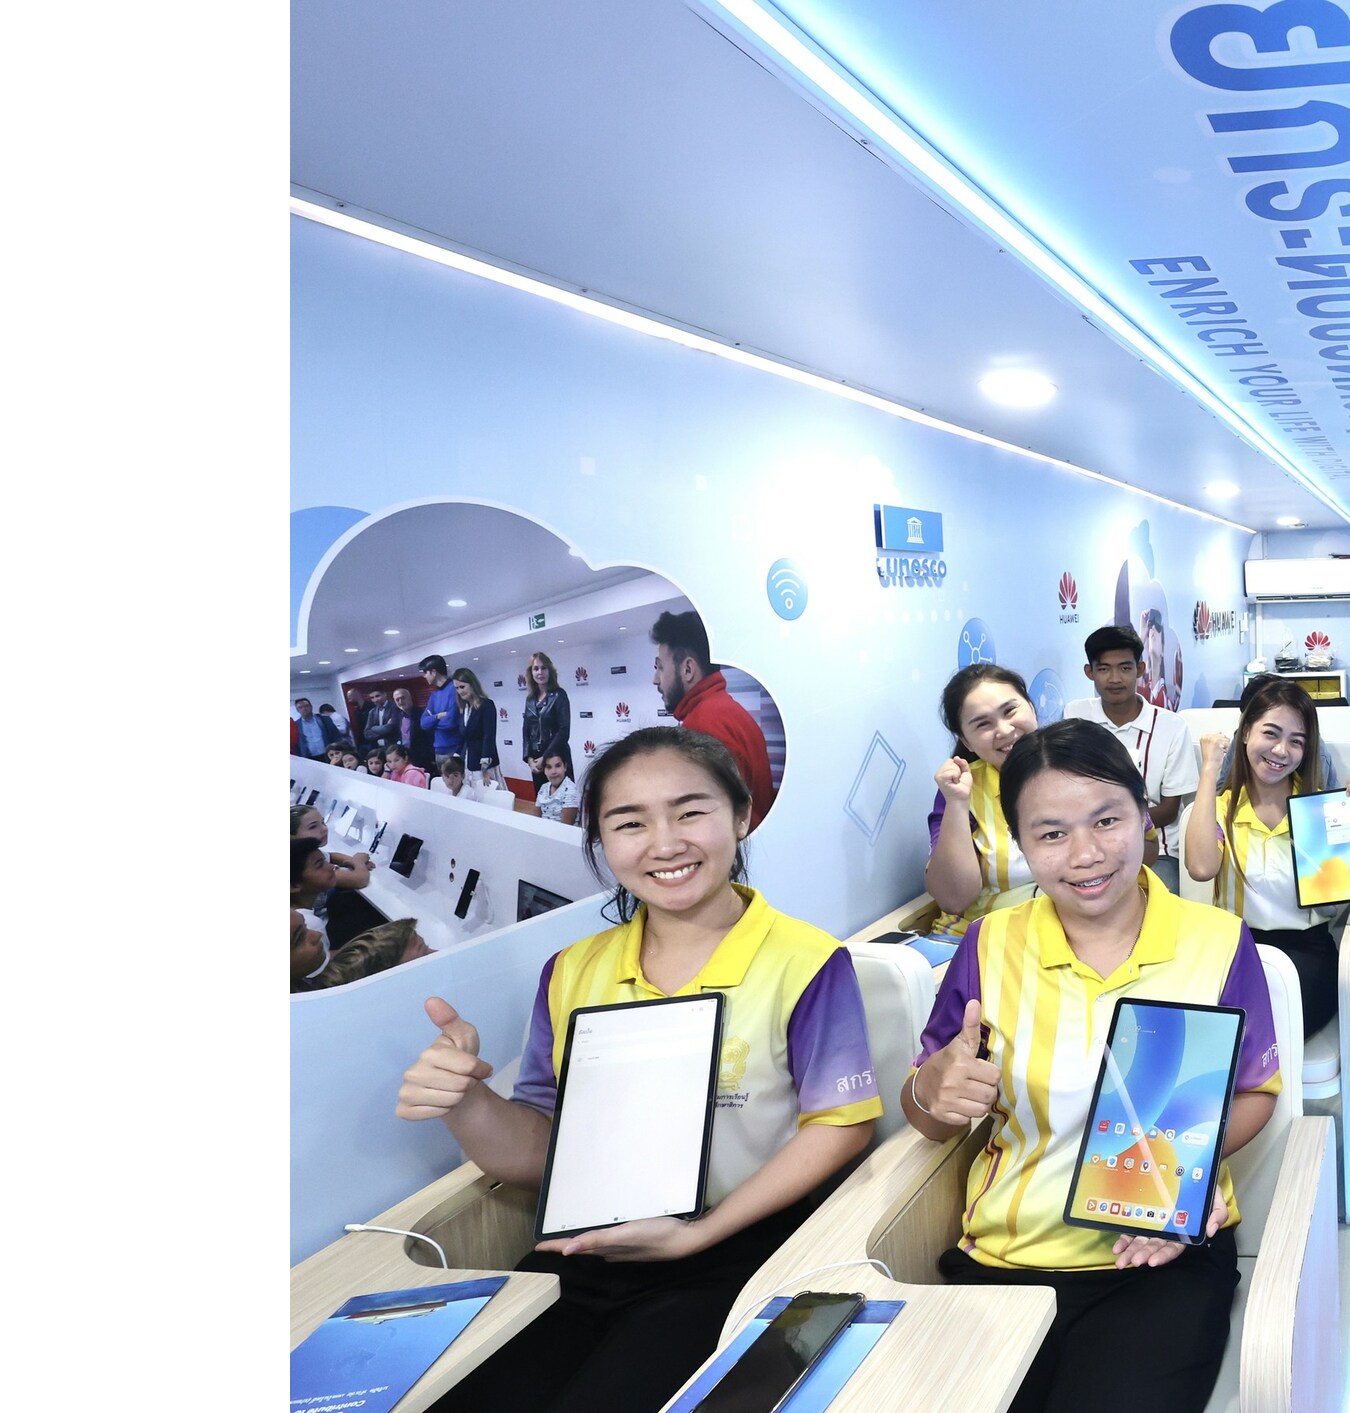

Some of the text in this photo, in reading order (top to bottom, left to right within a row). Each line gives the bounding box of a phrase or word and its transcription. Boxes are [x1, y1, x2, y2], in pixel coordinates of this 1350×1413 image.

[1129, 255, 1269, 357] ENRICH
[1229, 363, 1302, 407] YOUR
[1268, 411, 1321, 433] LIFE
[1292, 435, 1337, 457] WITH
[1059, 613, 1080, 624] HUAWEI
